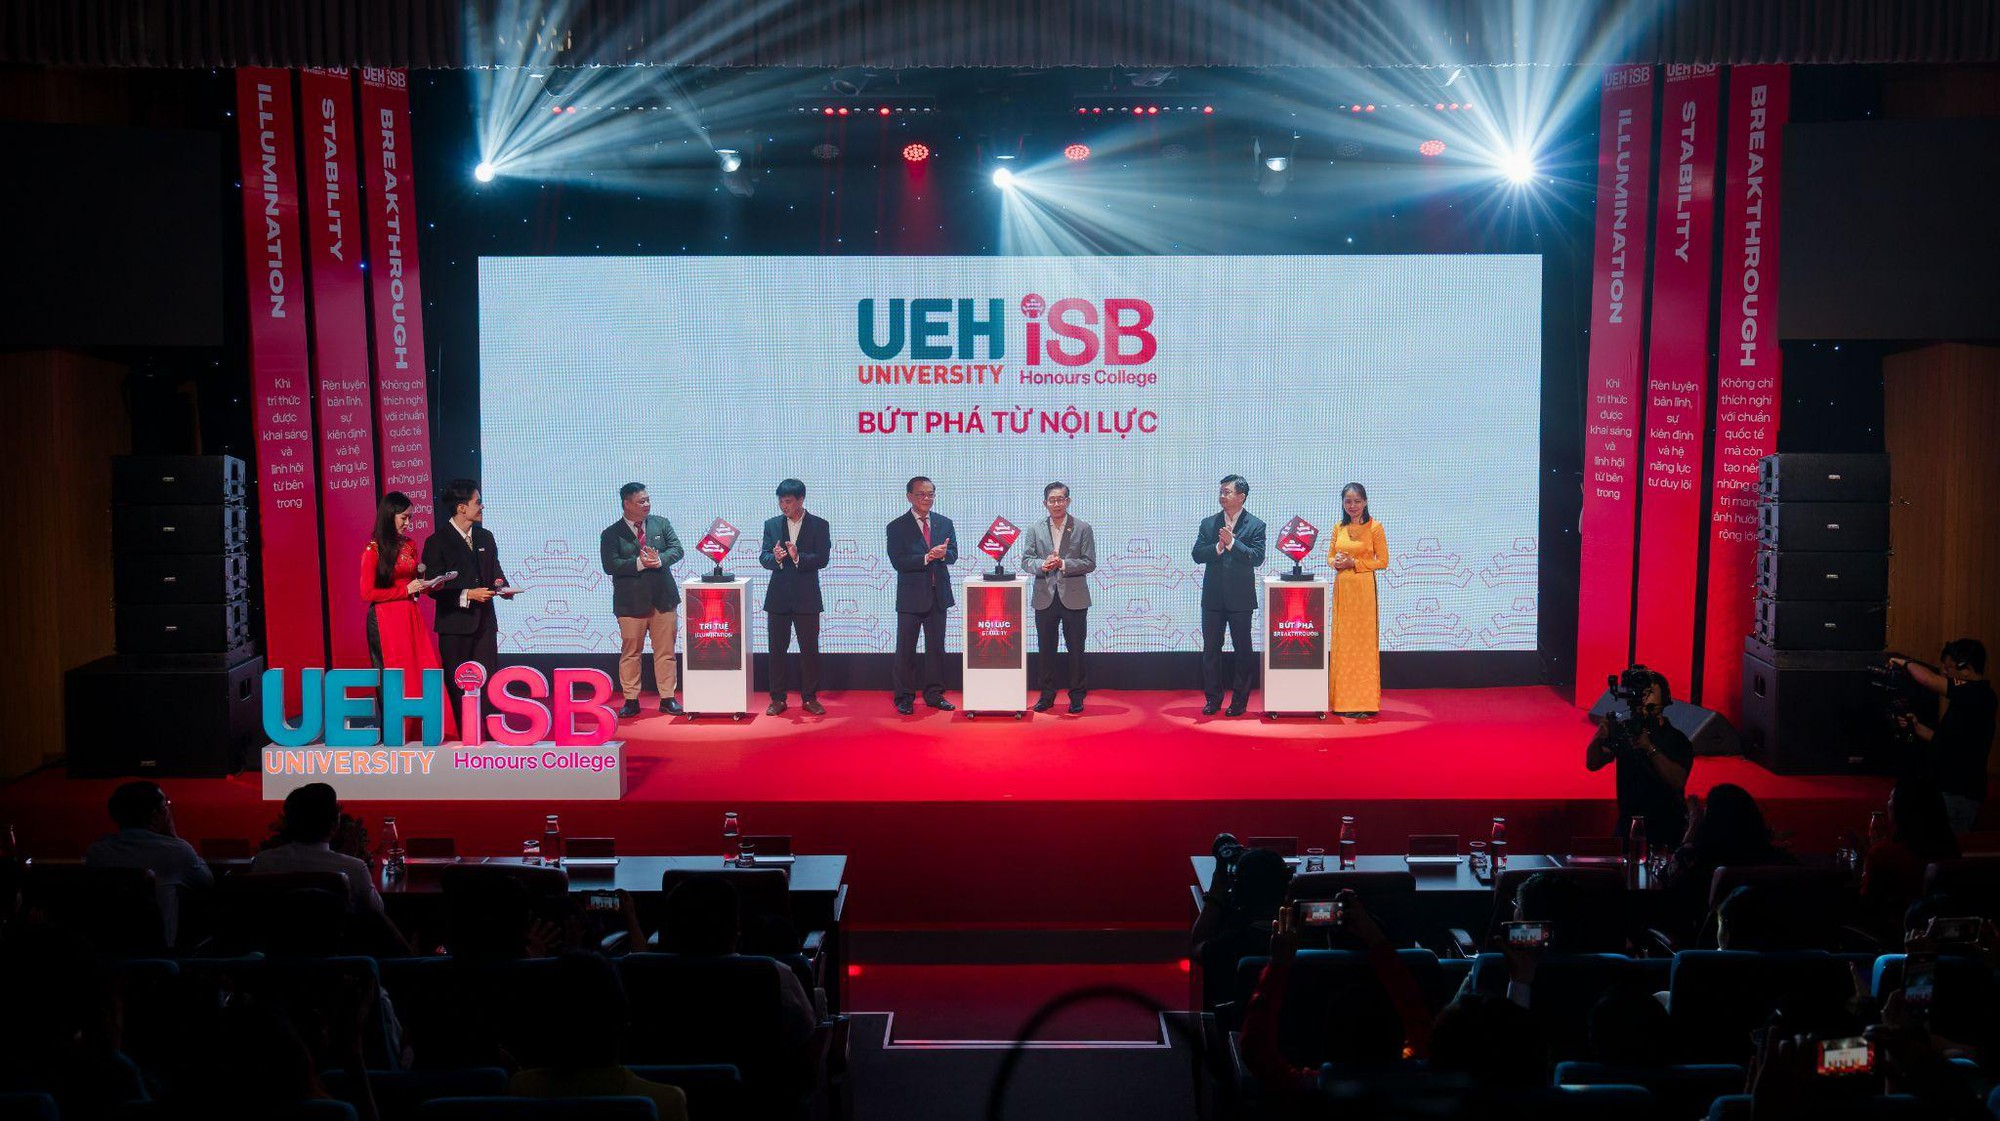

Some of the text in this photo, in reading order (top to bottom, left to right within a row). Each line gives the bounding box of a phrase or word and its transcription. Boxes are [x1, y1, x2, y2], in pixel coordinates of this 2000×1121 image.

[387, 69, 406, 88] iSB
[1604, 66, 1650, 86] UEH iSB
[321, 97, 344, 262] STABILITY
[1674, 100, 1697, 263] STABILITY
[257, 83, 286, 318] ILLUMINATION
[1609, 109, 1633, 323] ILLUMINATION
[1740, 85, 1768, 366] BREAKTHROUGH
[379, 108, 408, 370] BREAKTHROUGH
[858, 293, 1157, 366] UEH iSB
[858, 366, 1157, 387] UNIVERSITY Honours College
[274, 378, 291, 388] Khi
[322, 380, 365, 391] Rèn luyện
[381, 380, 410, 392] Không
[1606, 378, 1619, 388] Khi
[1651, 380, 1698, 393] Rèn luyện
[1721, 378, 1774, 390] Không chỉ
[267, 395, 300, 405] trí thức
[327, 396, 344, 406] bản
[384, 395, 423, 406] thích nghi
[1608, 395, 1628, 404] thức
[1654, 396, 1692, 408] bản lĩnh,
[1722, 395, 1771, 407] thích nghi
[272, 413, 297, 425] được
[340, 414, 352, 424] sự
[385, 409, 424, 421] với chuẩn
[1600, 410, 1623, 421] được
[1666, 414, 1680, 425] sự
[1721, 410, 1770, 422] với chuẩn
[858, 406, 1157, 439] BỨT PHÁ TỪ NỘI LỰC
[263, 429, 308, 440] khai sáng
[327, 428, 366, 440] kiên định
[390, 424, 422, 438] quốc tế
[1590, 425, 1632, 438] khai sáng
[1650, 428, 1694, 442] kiên định
[1725, 427, 1764, 440] quốc tế
[281, 446, 293, 456] và
[336, 445, 360, 456] và hệ
[391, 443, 422, 452] mà còn
[1605, 441, 1616, 450] và
[1658, 445, 1684, 458] và hệ
[1724, 445, 1763, 456] mà còn
[330, 462, 368, 473] năng lực
[392, 458, 424, 470] tạo nên
[1594, 456, 1625, 469] lĩnh hội
[1650, 461, 1691, 475] năng lực
[1723, 462, 1740, 474] tạo
[271, 463, 304, 475] lĩnh hội
[330, 476, 369, 489] tư duy lõi
[388, 473, 429, 485] những giá
[1595, 472, 1623, 483] từ bên
[1648, 477, 1692, 490] tư duy lõi
[273, 479, 304, 491] từ bên
[1717, 479, 1749, 492] những
[1597, 488, 1620, 500] trong
[277, 499, 302, 508] trong
[1720, 495, 1730, 508] trị
[1713, 511, 1732, 522] ảnh
[416, 520, 428, 529] lớn
[1719, 529, 1742, 542] rộng
[713, 622, 729, 631] TUỆ
[978, 620, 994, 630] NỘI
[1296, 620, 1314, 628] PHÁ
[262, 661, 619, 747] UEH iSB
[264, 750, 616, 775] UNIVERSITY Honours College
